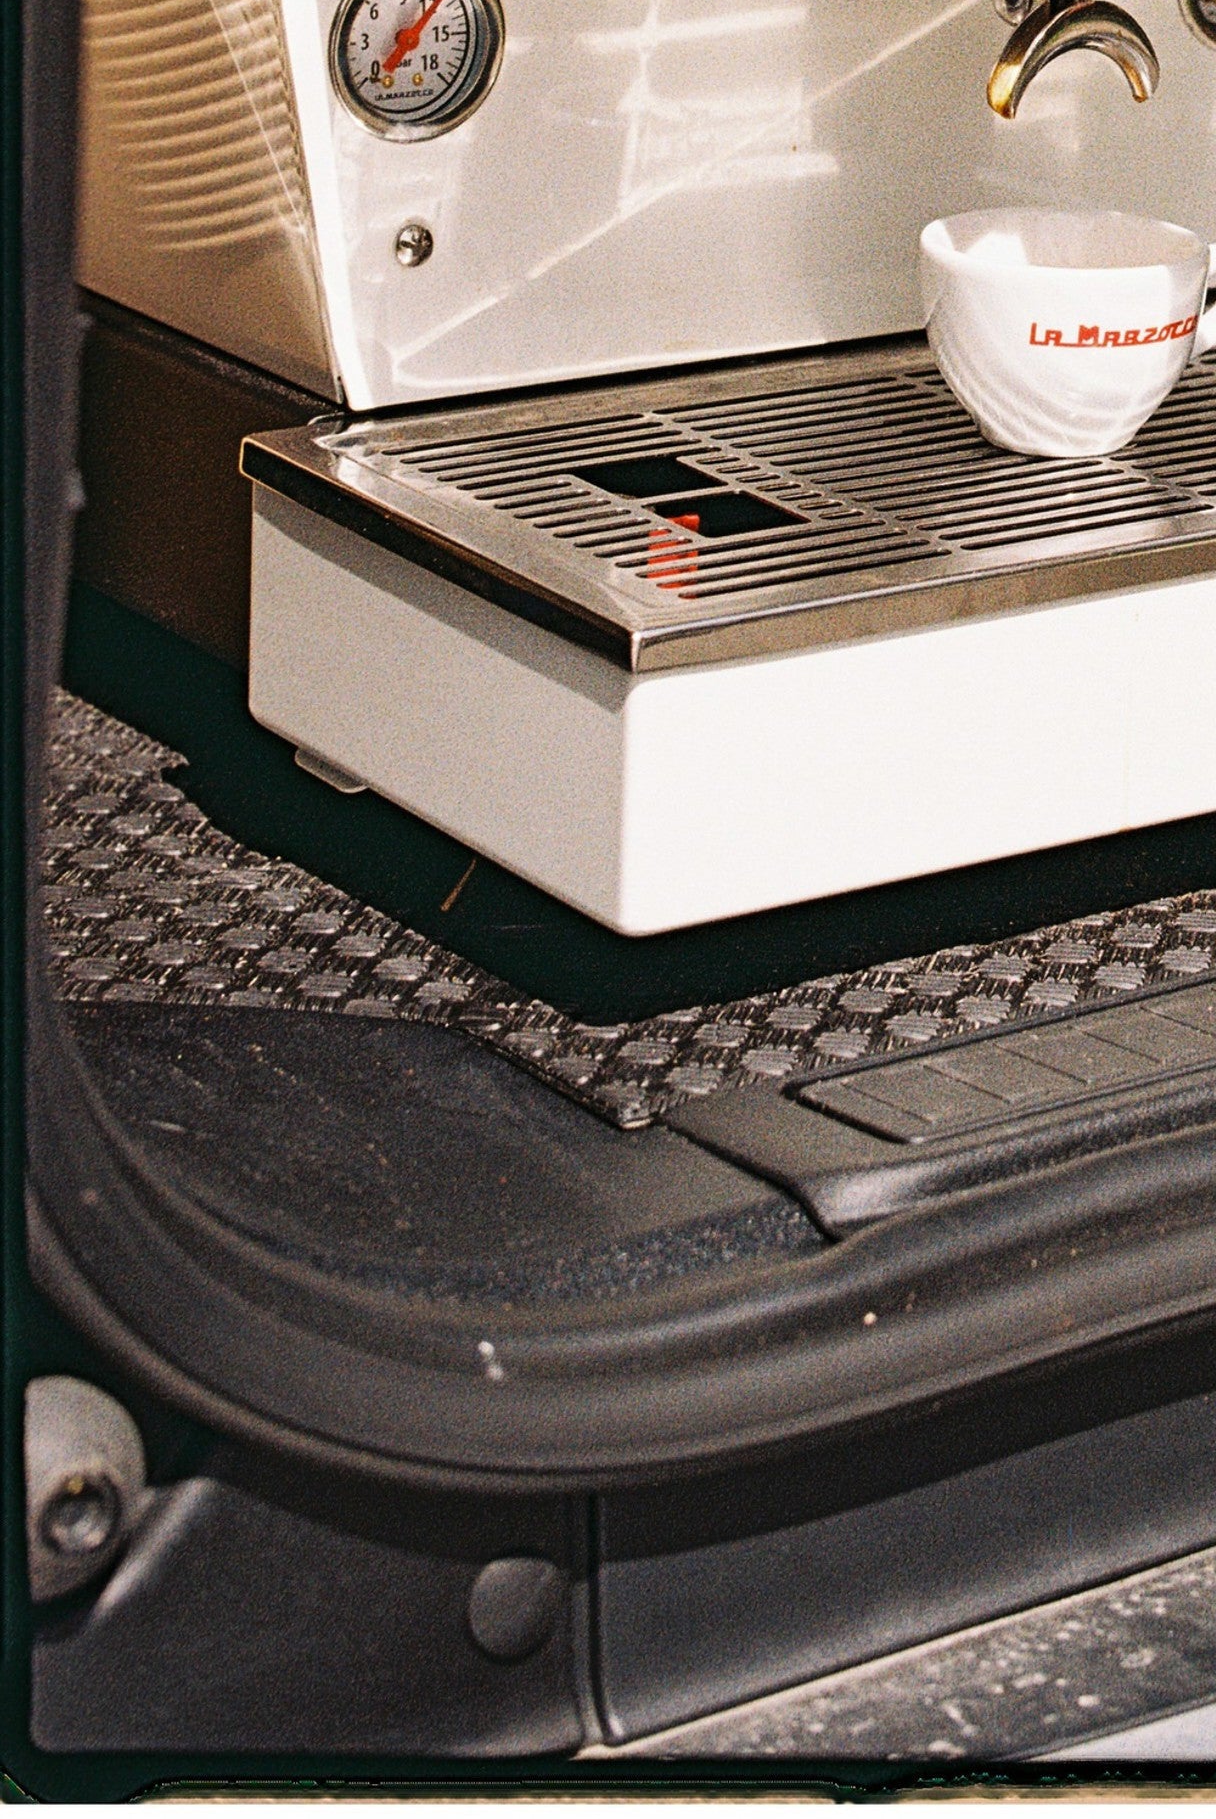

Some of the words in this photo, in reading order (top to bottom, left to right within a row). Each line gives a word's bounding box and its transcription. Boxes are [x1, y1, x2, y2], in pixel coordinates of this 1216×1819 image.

[369, 3, 379, 20] 6
[360, 33, 370, 50] 3
[433, 25, 450, 43] 15
[370, 60, 380, 80] 0
[421, 53, 439, 72] 18
